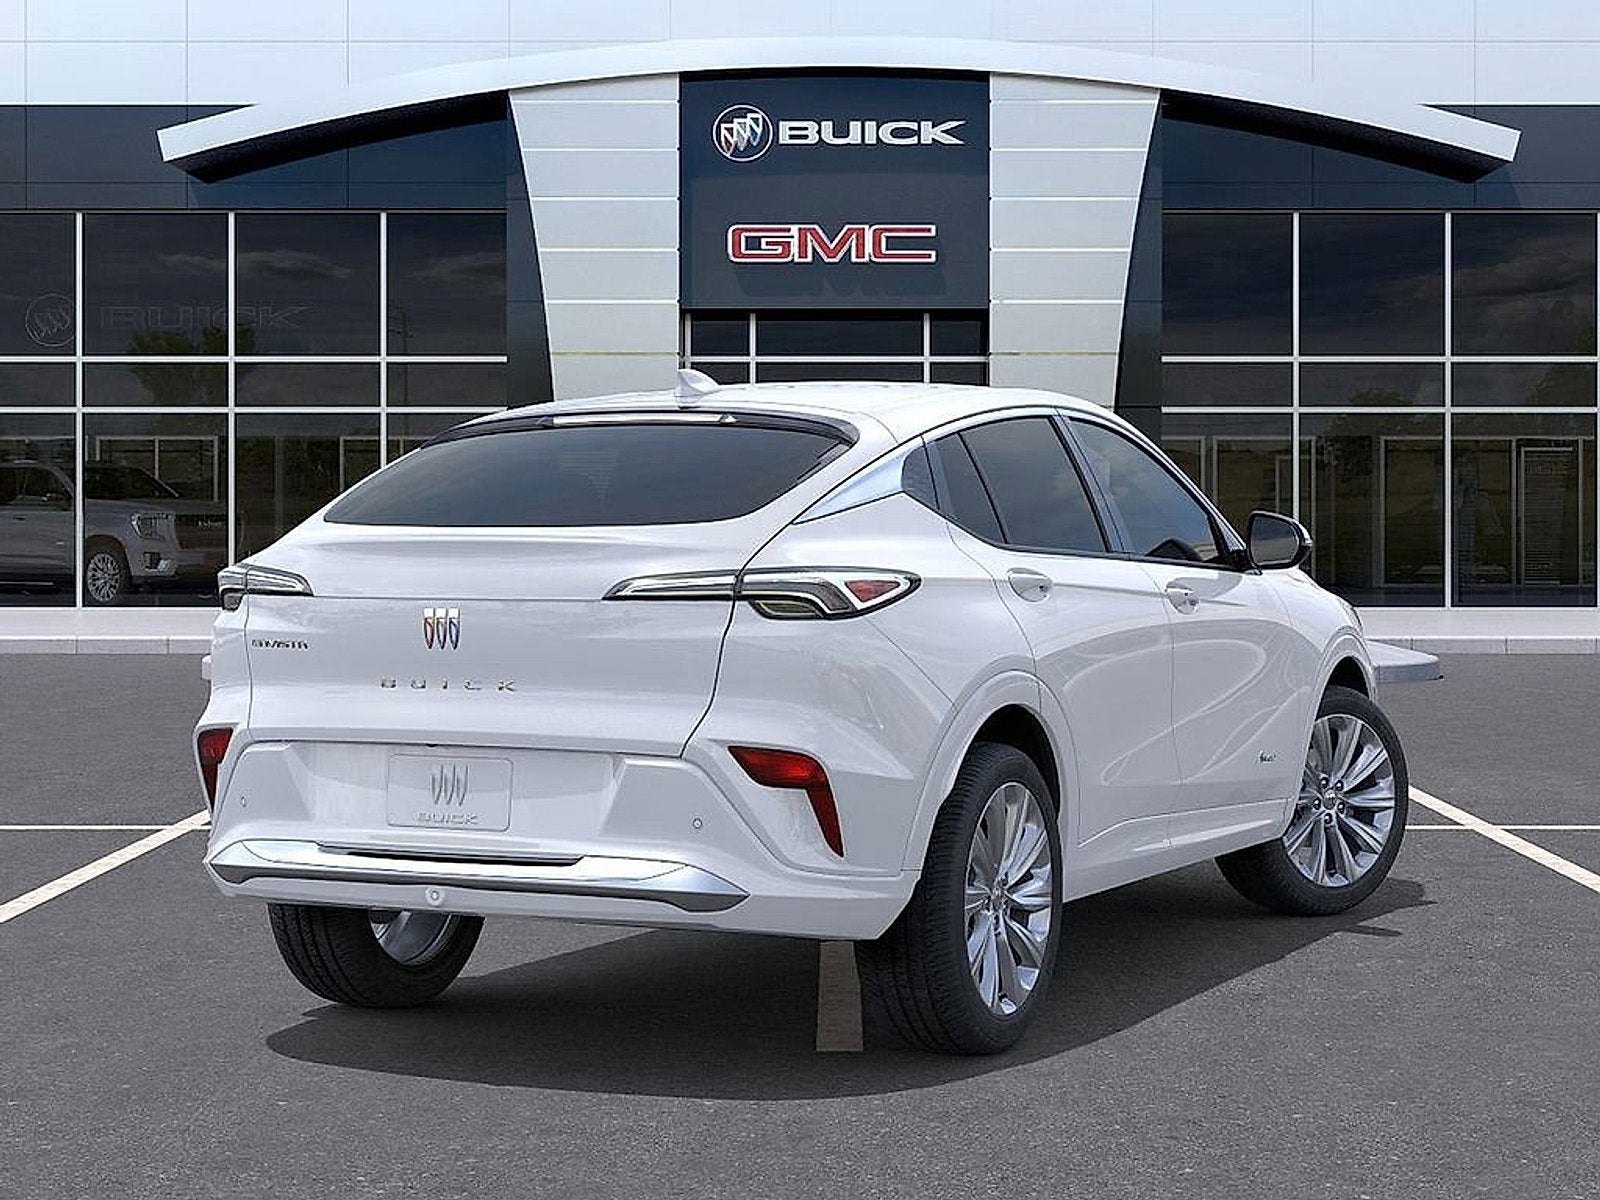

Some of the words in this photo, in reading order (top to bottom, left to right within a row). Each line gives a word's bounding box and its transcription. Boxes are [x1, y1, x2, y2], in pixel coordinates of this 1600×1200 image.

[778, 120, 966, 145] BUICK
[727, 224, 937, 263] GMC
[380, 676, 518, 693] BUICK
[417, 811, 479, 825] BUICK
